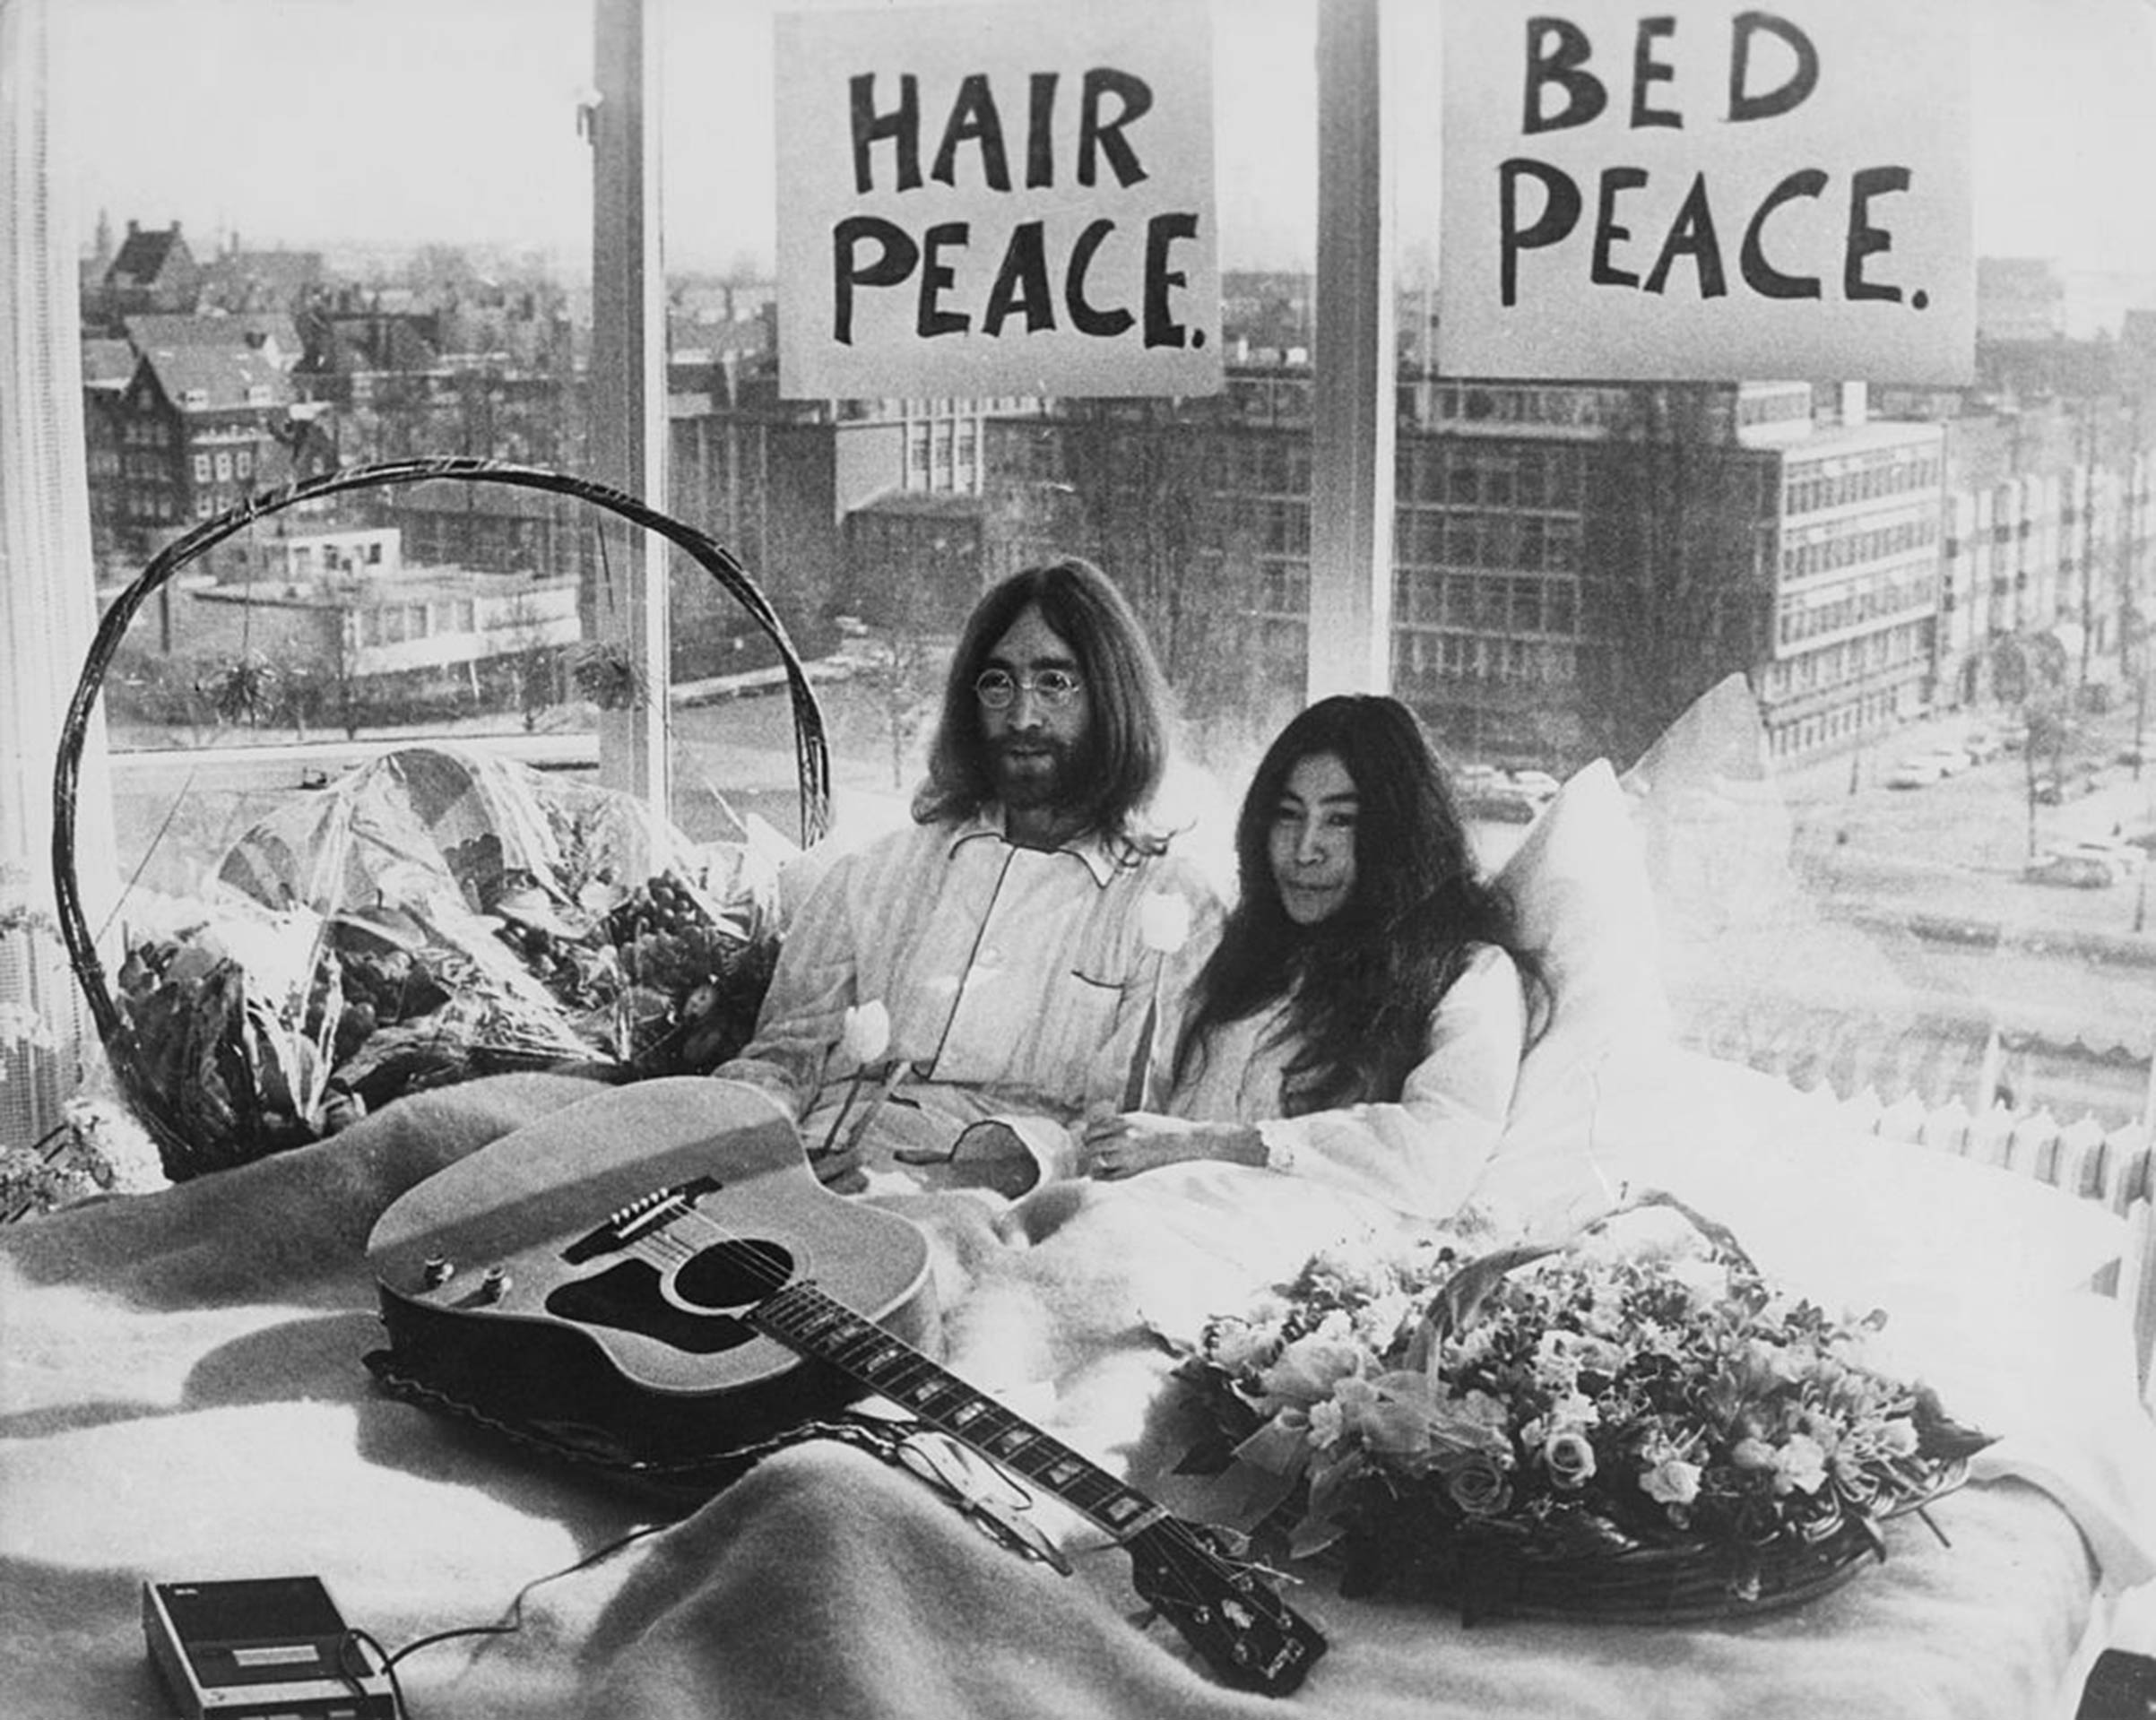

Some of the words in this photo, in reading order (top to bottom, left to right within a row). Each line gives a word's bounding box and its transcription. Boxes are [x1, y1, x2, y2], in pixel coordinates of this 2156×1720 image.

[850, 67, 1153, 194] HAIR
[1521, 12, 1819, 135] BED
[833, 213, 1206, 350] PEACE.
[1498, 158, 1929, 310] PEACE.
